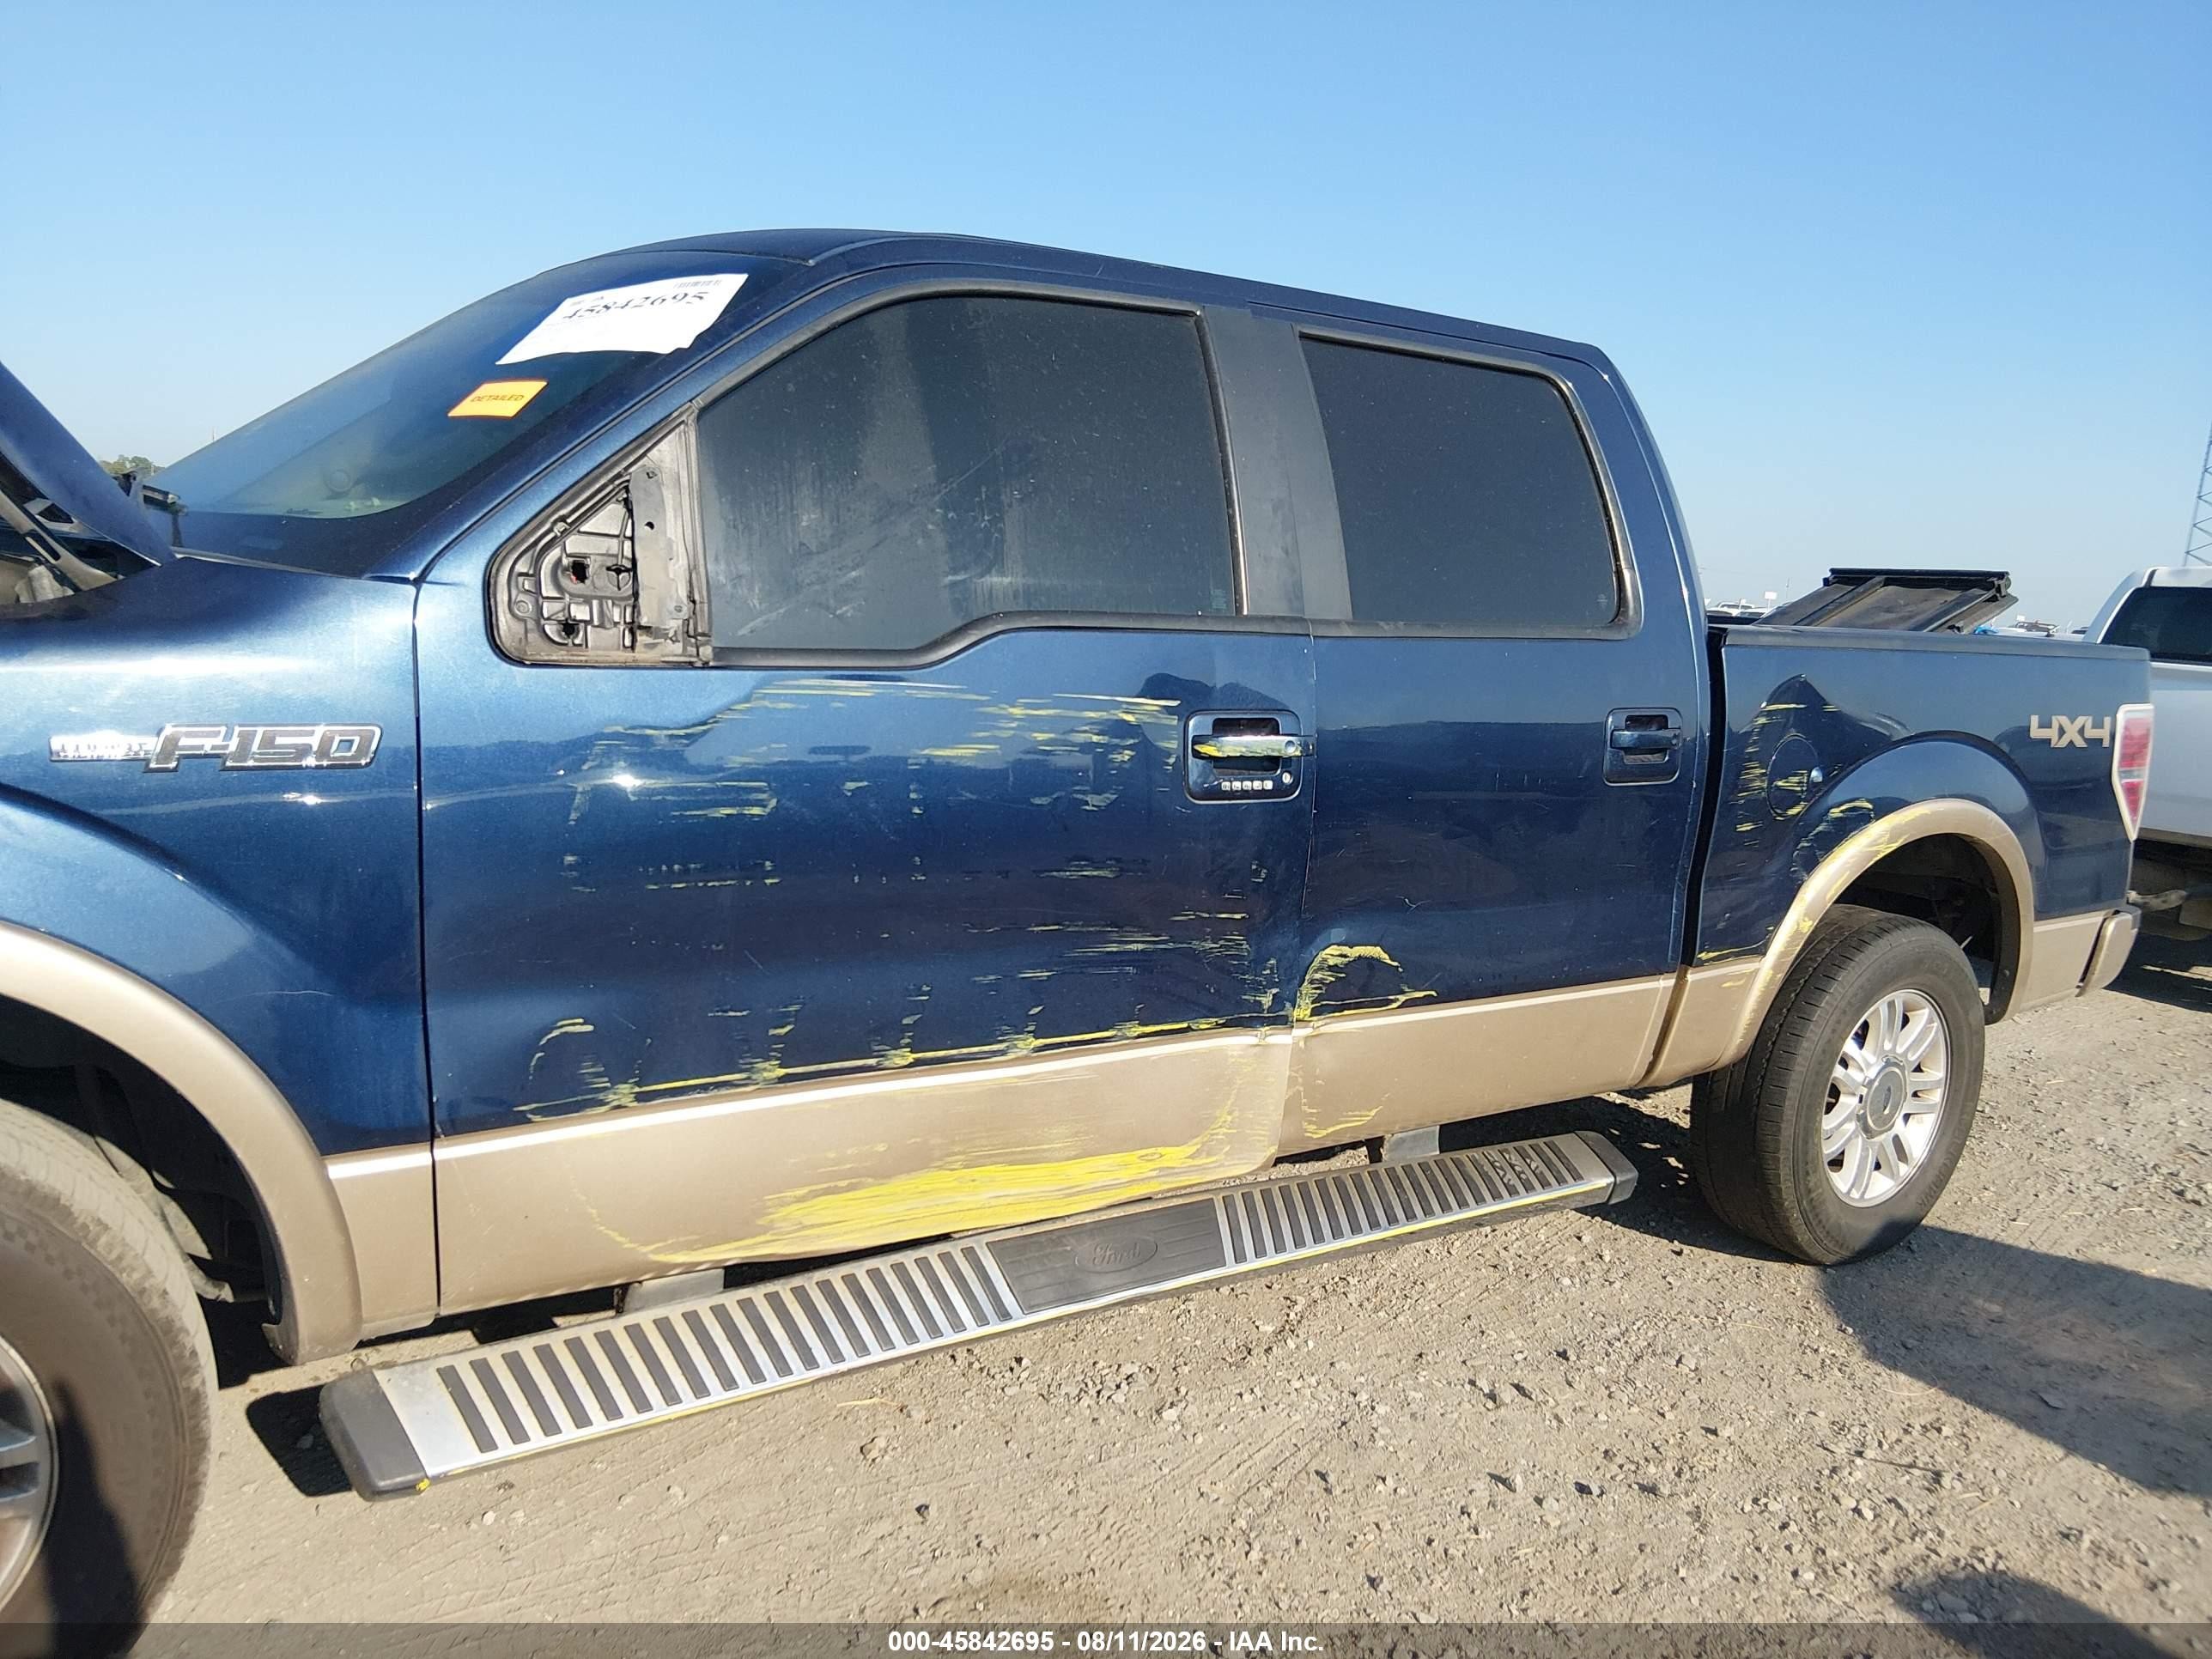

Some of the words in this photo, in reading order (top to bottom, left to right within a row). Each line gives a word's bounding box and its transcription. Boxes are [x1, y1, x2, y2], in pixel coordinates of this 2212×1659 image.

[562, 291, 709, 320] 45842695
[471, 393, 525, 403] DETAILED
[2029, 714, 2112, 748] 4X4
[143, 724, 383, 772] F-150
[1092, 1243, 1142, 1267] Ford
